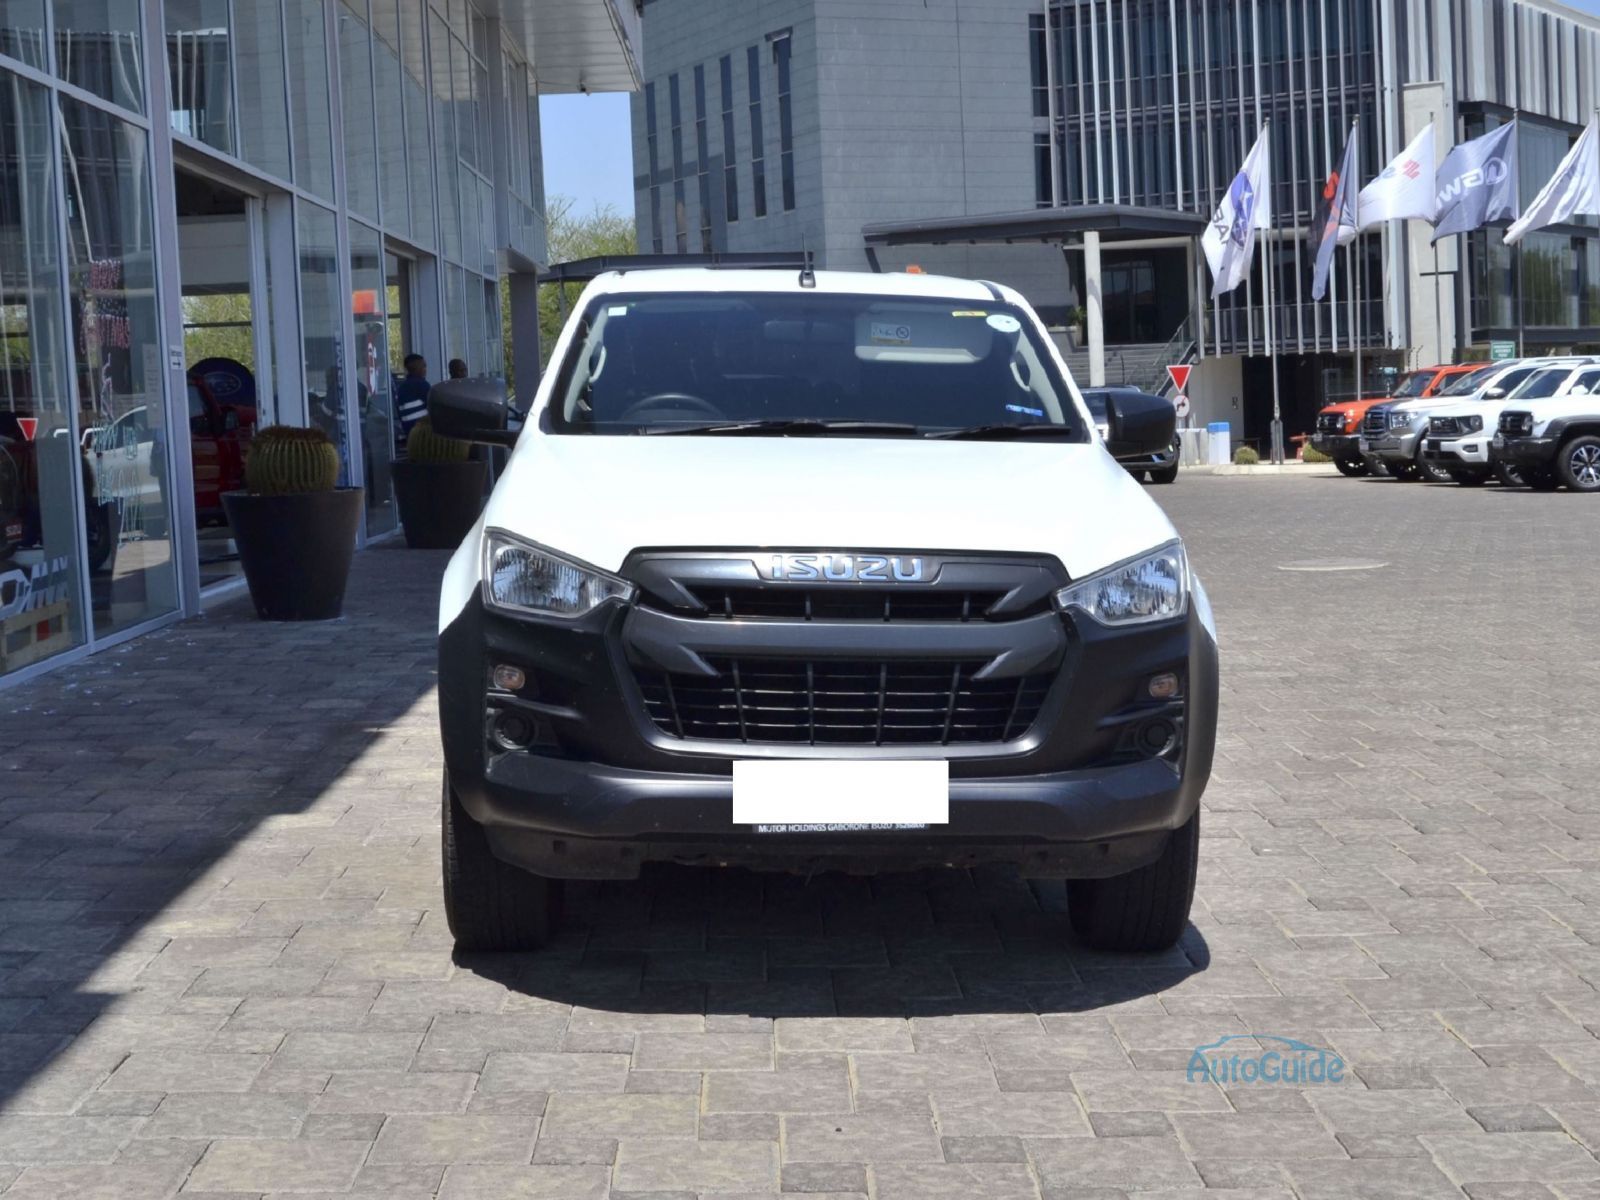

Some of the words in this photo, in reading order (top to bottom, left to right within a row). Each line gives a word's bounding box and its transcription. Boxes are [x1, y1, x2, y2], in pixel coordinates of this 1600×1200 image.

[772, 555, 922, 580] ISUZU
[758, 824, 787, 833] MOTOR
[788, 823, 827, 832] HOLDINGS
